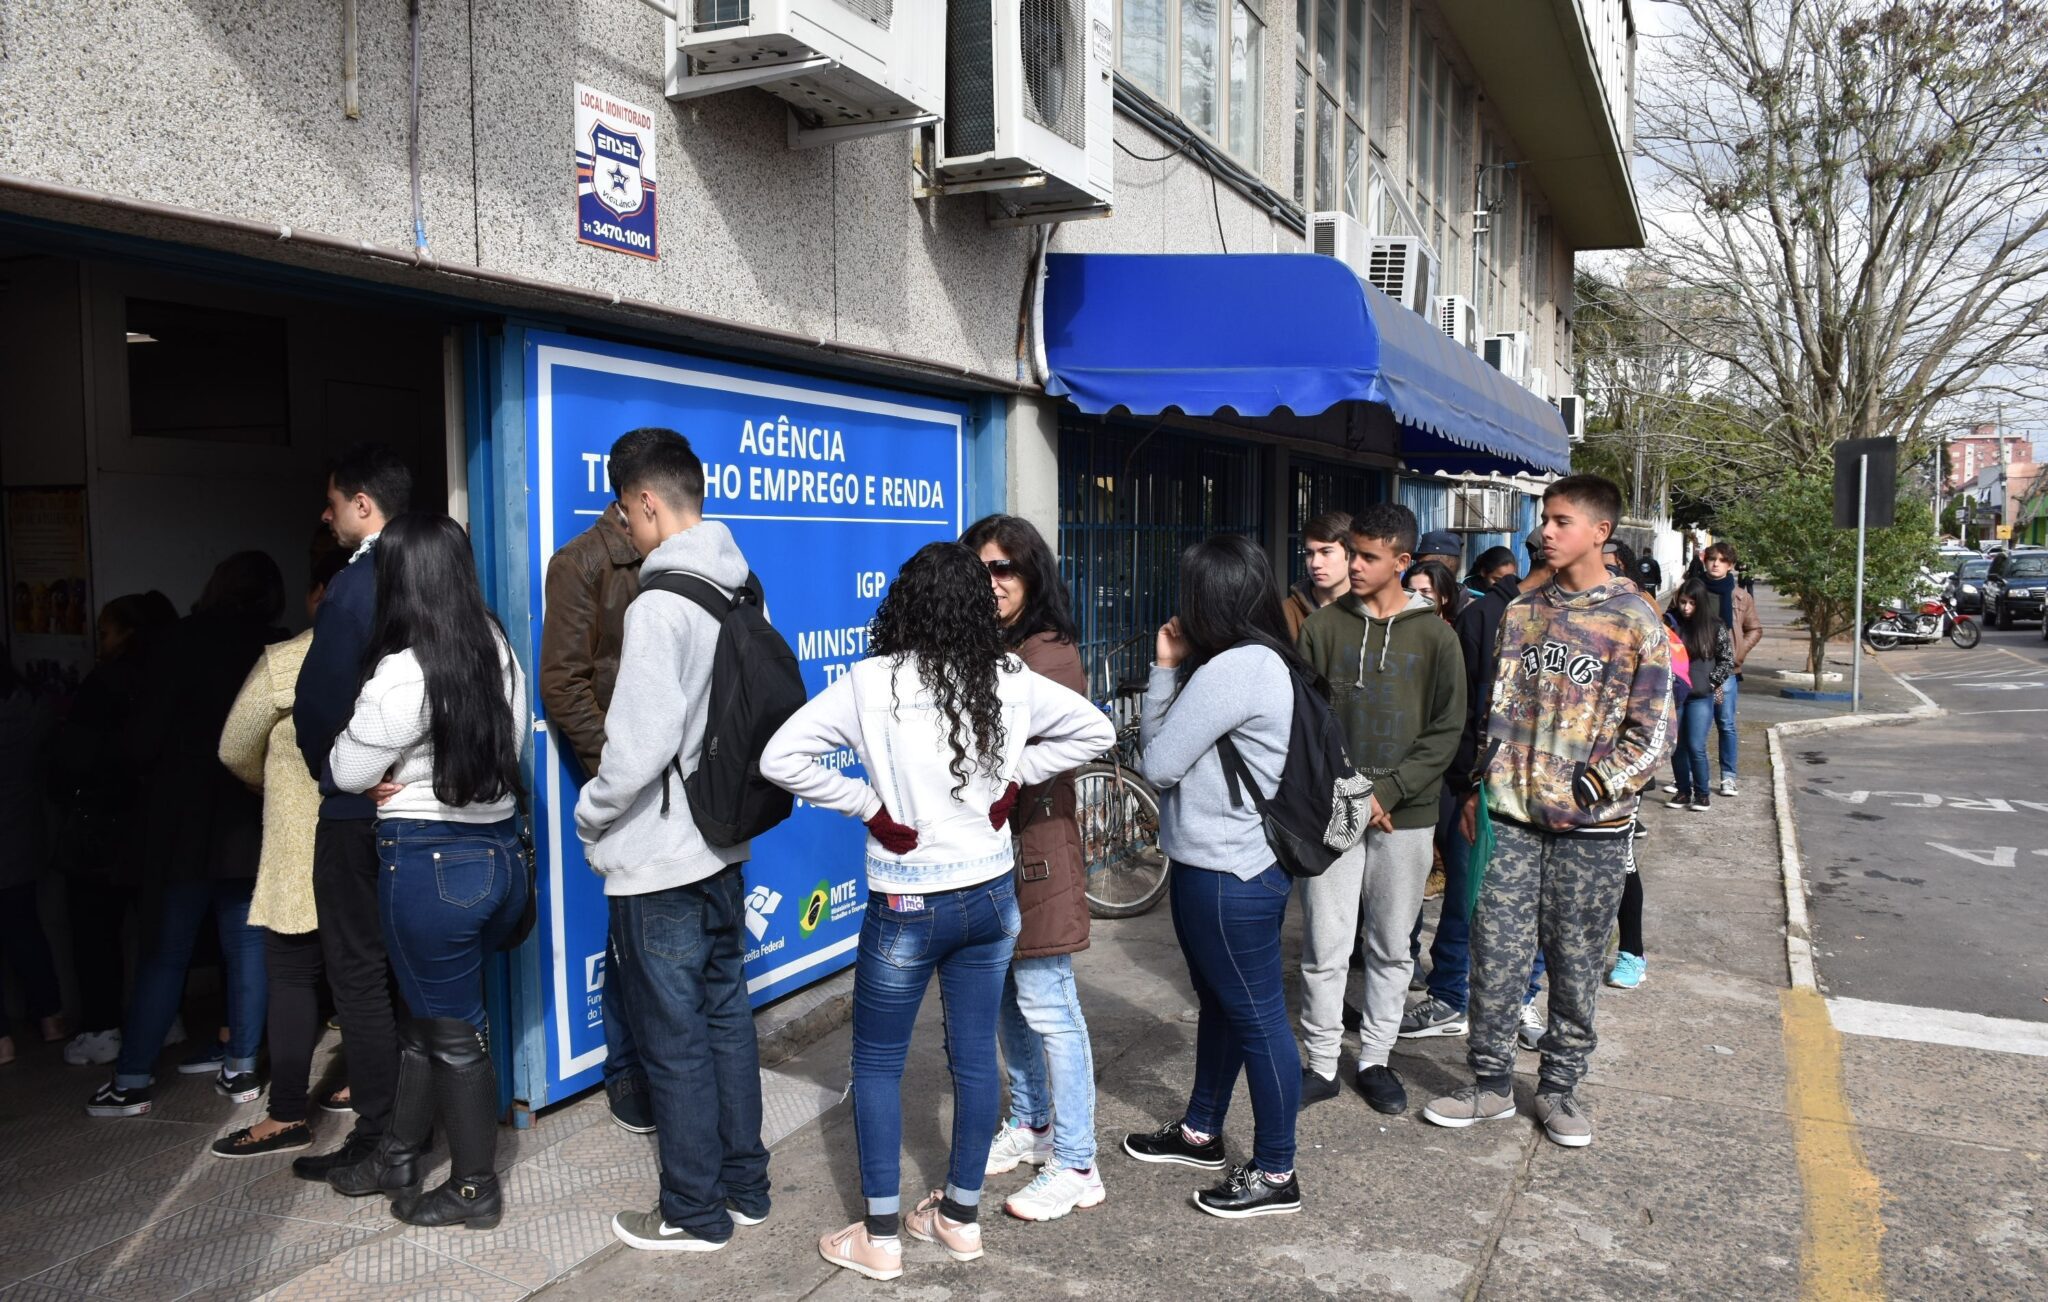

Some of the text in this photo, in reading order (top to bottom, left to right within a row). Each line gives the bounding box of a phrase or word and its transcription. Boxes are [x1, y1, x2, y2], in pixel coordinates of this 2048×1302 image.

[580, 90, 651, 130] LOCAL MONITORADO
[583, 220, 651, 250] 51 3470.1001
[739, 415, 846, 462] AGÊNCIA
[749, 466, 859, 505] EMPREGO
[865, 475, 876, 506] E
[882, 477, 944, 509] RENDA
[856, 571, 886, 599] IGP
[799, 620, 876, 661] MINIST
[831, 879, 857, 907] MTE
[743, 935, 785, 963] ceita Federal
